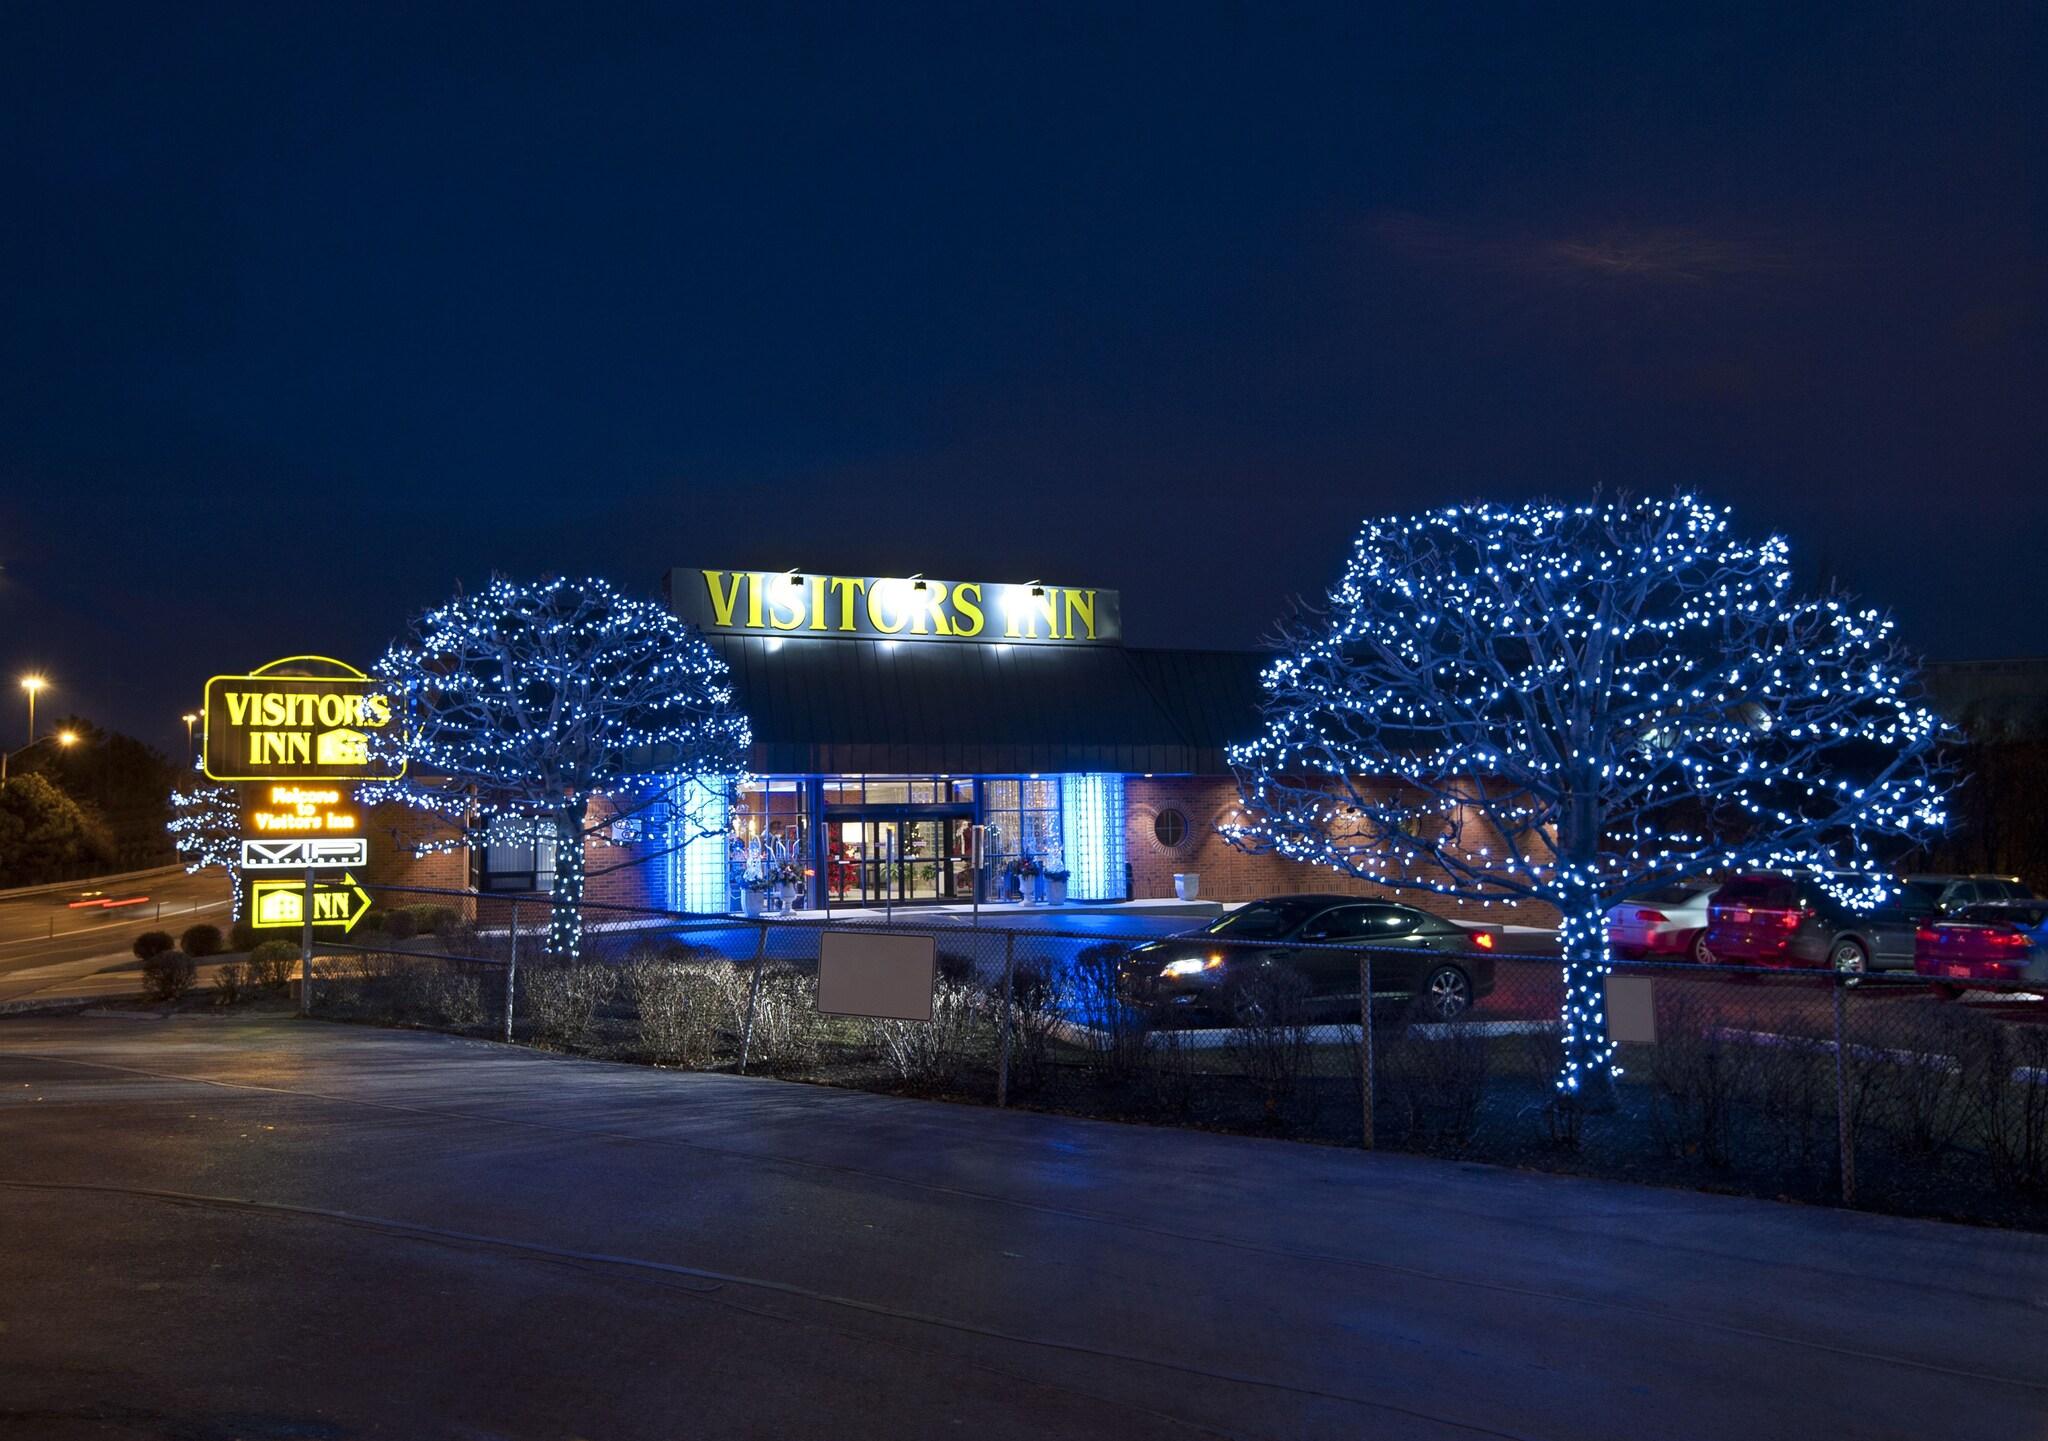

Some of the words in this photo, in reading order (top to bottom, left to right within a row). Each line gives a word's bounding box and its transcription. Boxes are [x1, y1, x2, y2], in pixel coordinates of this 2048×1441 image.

[702, 569, 985, 637] VISITORS
[1003, 585, 1098, 640] INN
[224, 692, 391, 728] VISITORS
[249, 731, 312, 765] INN
[249, 842, 361, 860] VIP
[313, 891, 350, 919] NN
